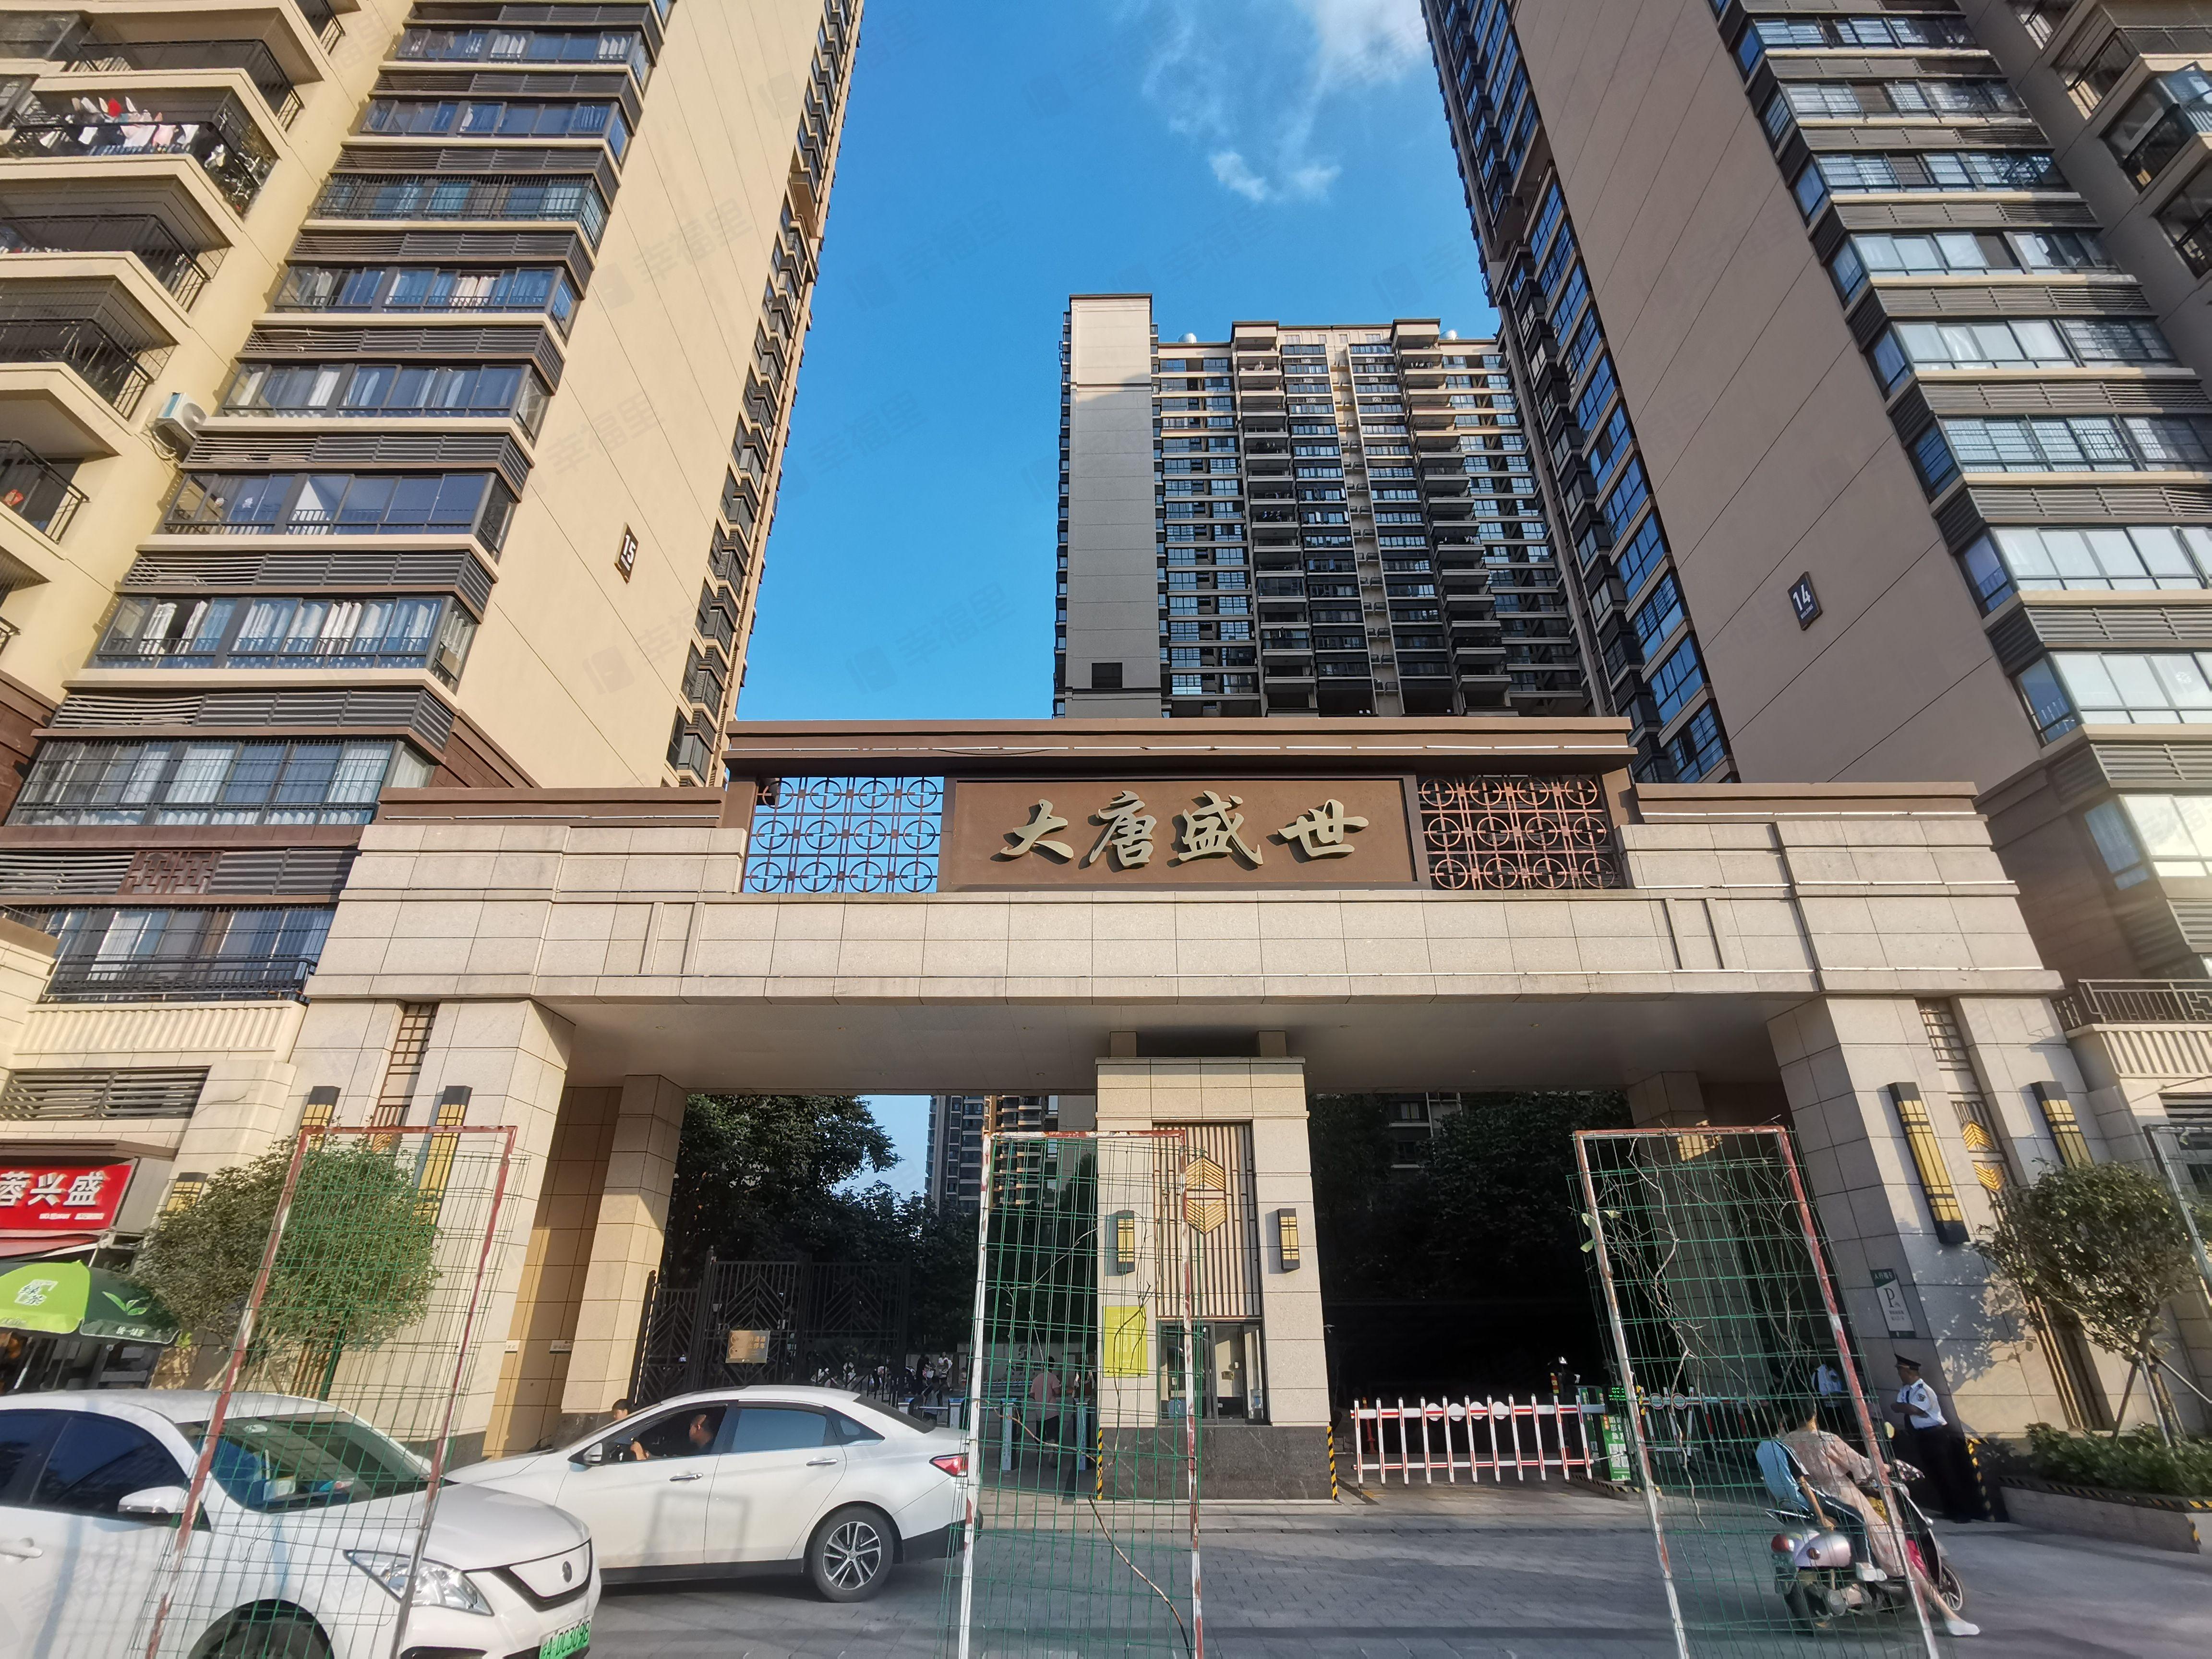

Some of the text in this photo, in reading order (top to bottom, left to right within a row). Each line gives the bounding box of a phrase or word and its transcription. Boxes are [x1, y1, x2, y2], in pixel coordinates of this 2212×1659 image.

[623, 534, 636, 564] 15
[1793, 584, 1811, 611] 14
[999, 790, 1370, 867] 大唐盛世
[0, 1170, 104, 1207] 蓉兴盛
[1884, 1288, 1895, 1308] P
